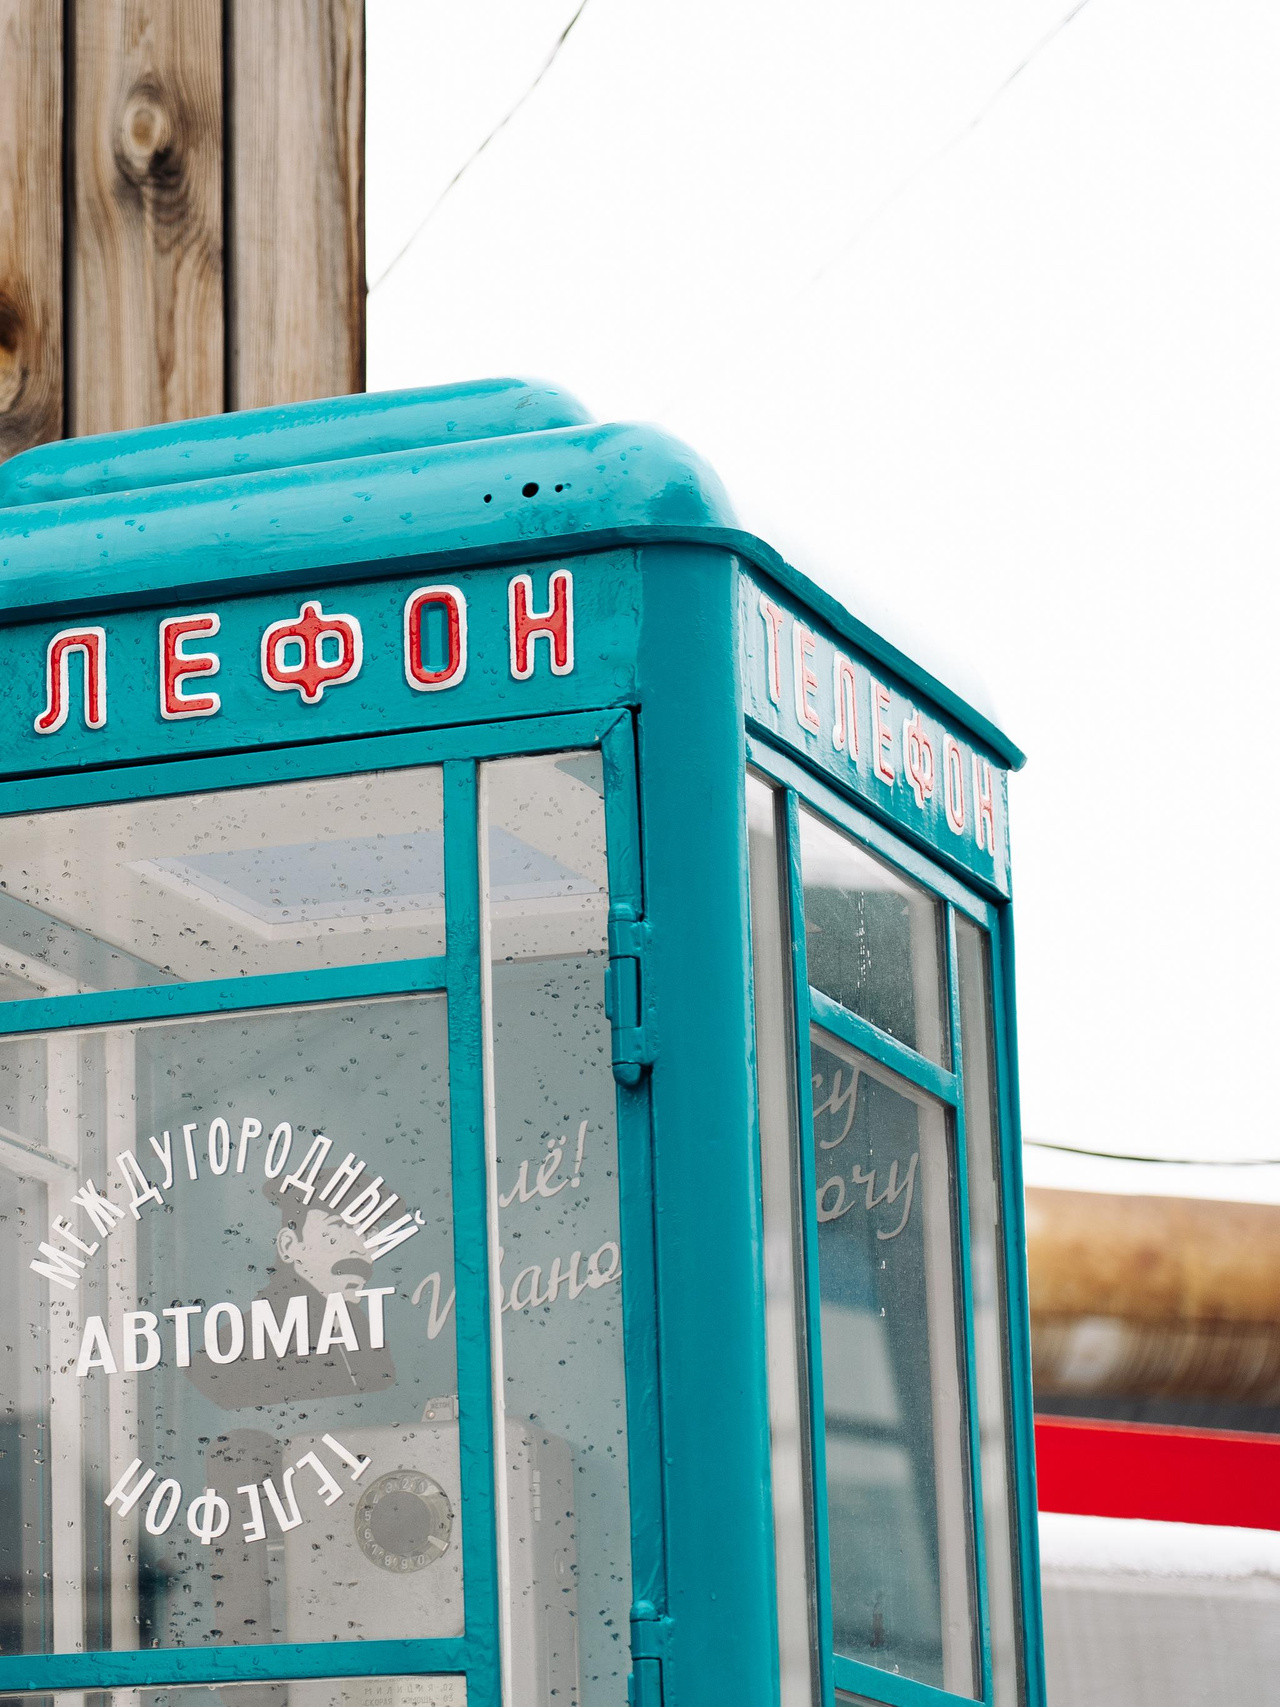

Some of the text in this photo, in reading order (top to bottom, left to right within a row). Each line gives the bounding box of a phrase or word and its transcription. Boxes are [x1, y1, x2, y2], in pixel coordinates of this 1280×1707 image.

[760, 593, 995, 857] ТЕЛЕФОН
[29, 1117, 426, 1290] МЕЖДУГОРОДНЫЙ
[499, 1120, 588, 1208] лё!
[75, 1286, 396, 1378] АВТОМАТ
[104, 1433, 372, 1545] ТЕЛЕФОН
